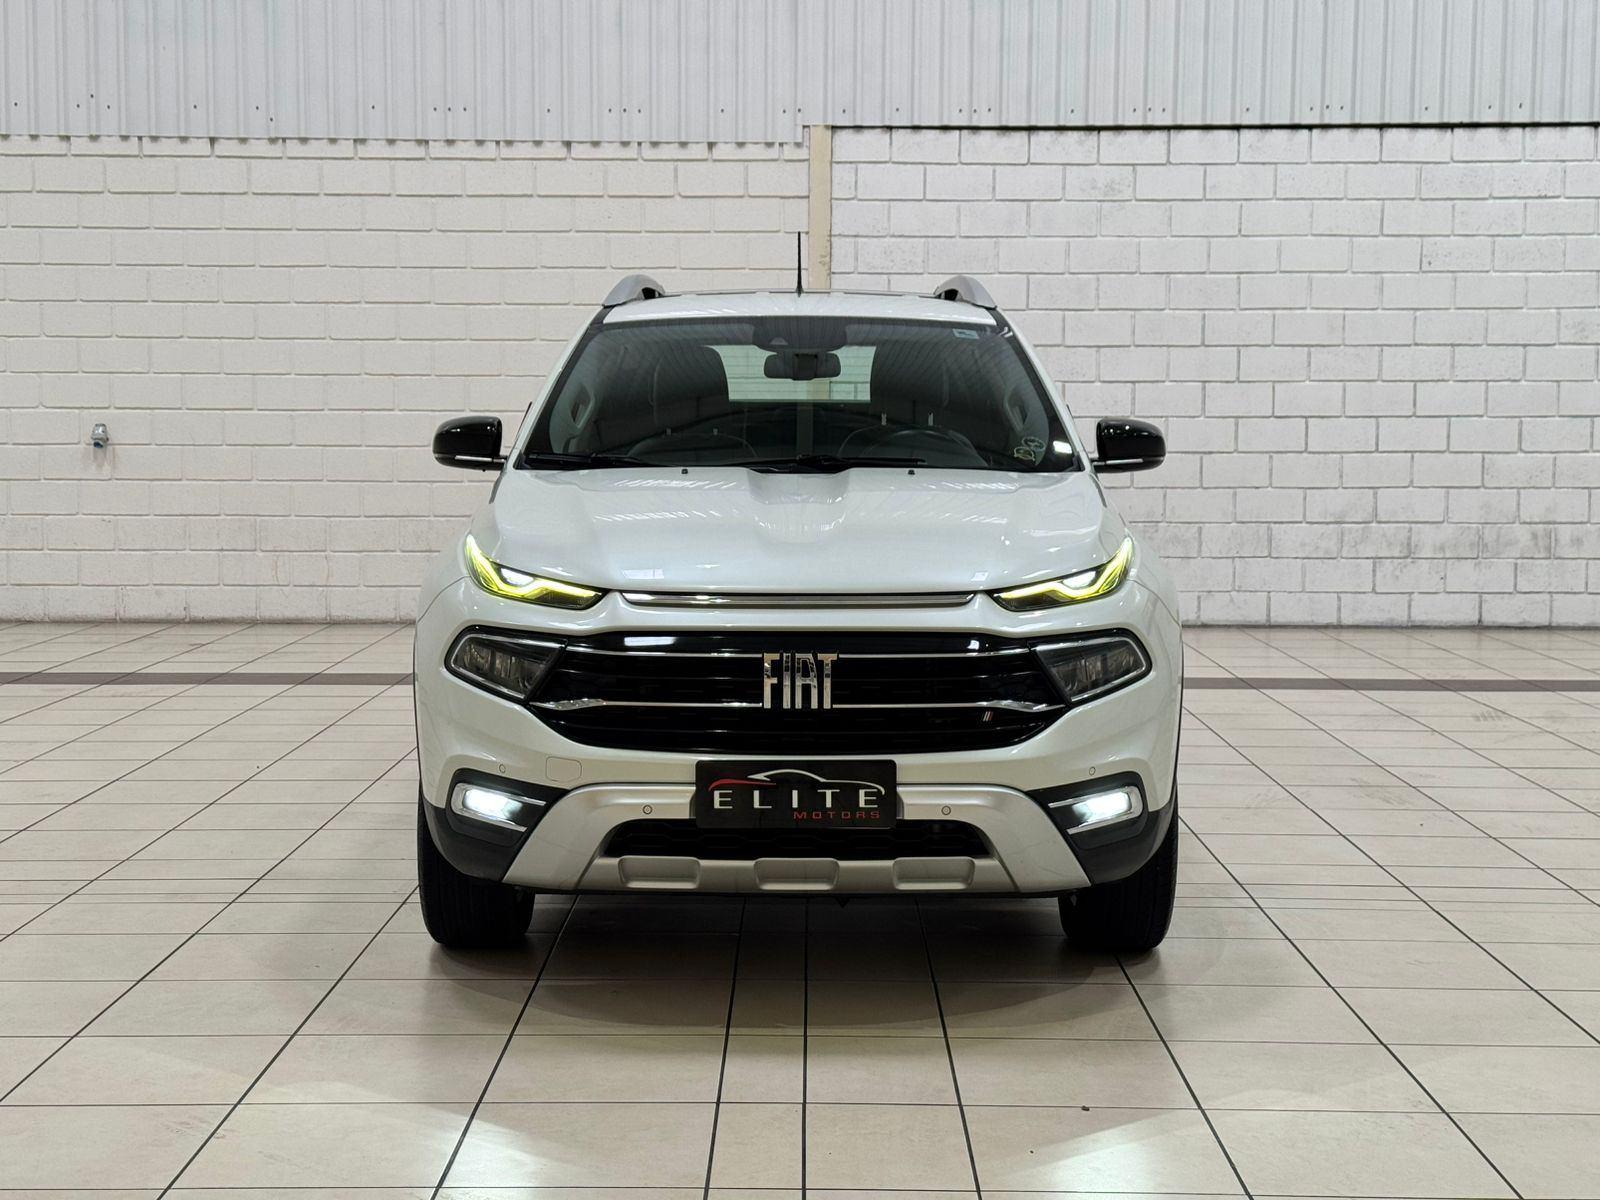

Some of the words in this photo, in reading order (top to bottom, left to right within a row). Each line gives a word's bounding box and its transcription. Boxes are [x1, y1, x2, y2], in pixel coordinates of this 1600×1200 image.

[763, 652, 838, 709] FIAT
[713, 788, 879, 809] ELITE
[793, 810, 881, 820] MOTORS
